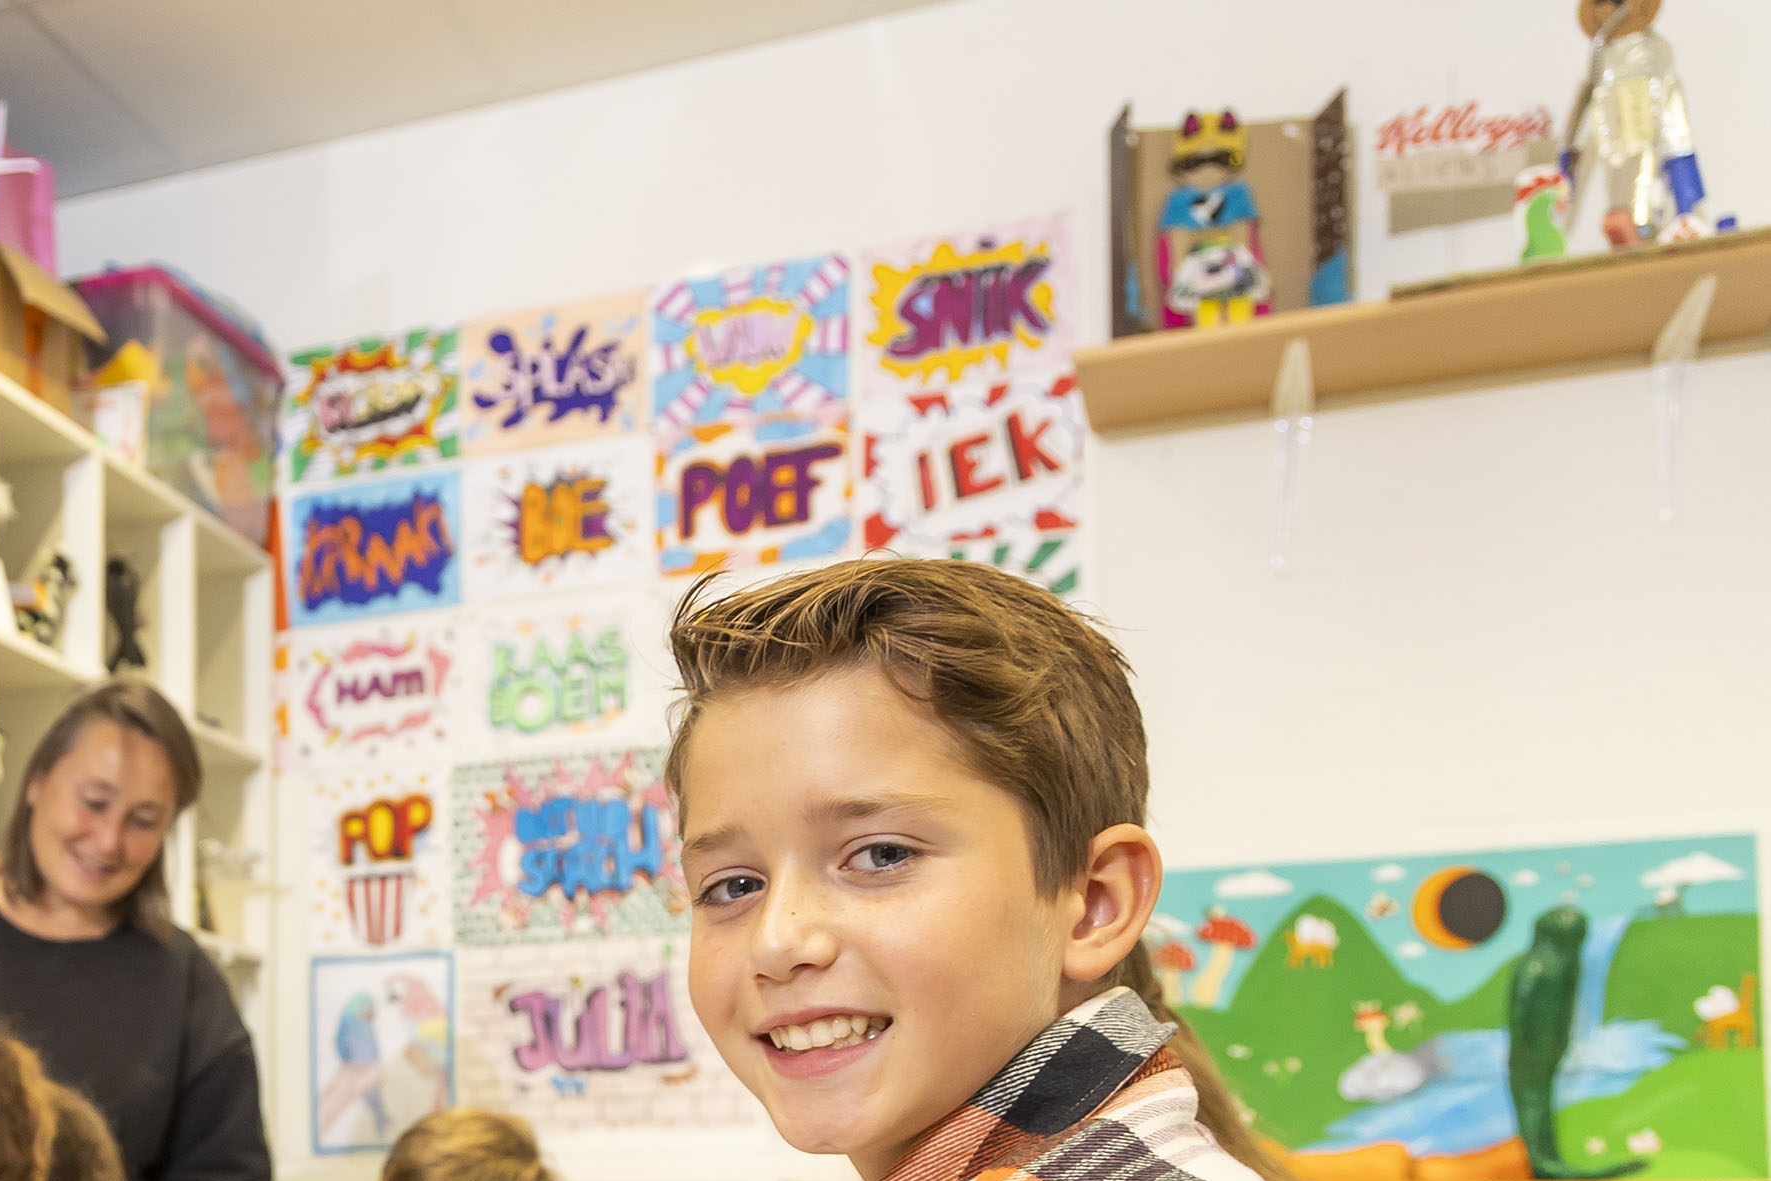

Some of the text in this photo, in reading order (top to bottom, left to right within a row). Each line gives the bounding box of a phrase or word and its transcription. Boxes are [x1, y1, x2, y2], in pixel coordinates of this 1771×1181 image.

[681, 442, 843, 540] POEF
[917, 411, 1061, 511] IEK
[339, 793, 434, 867] POP
